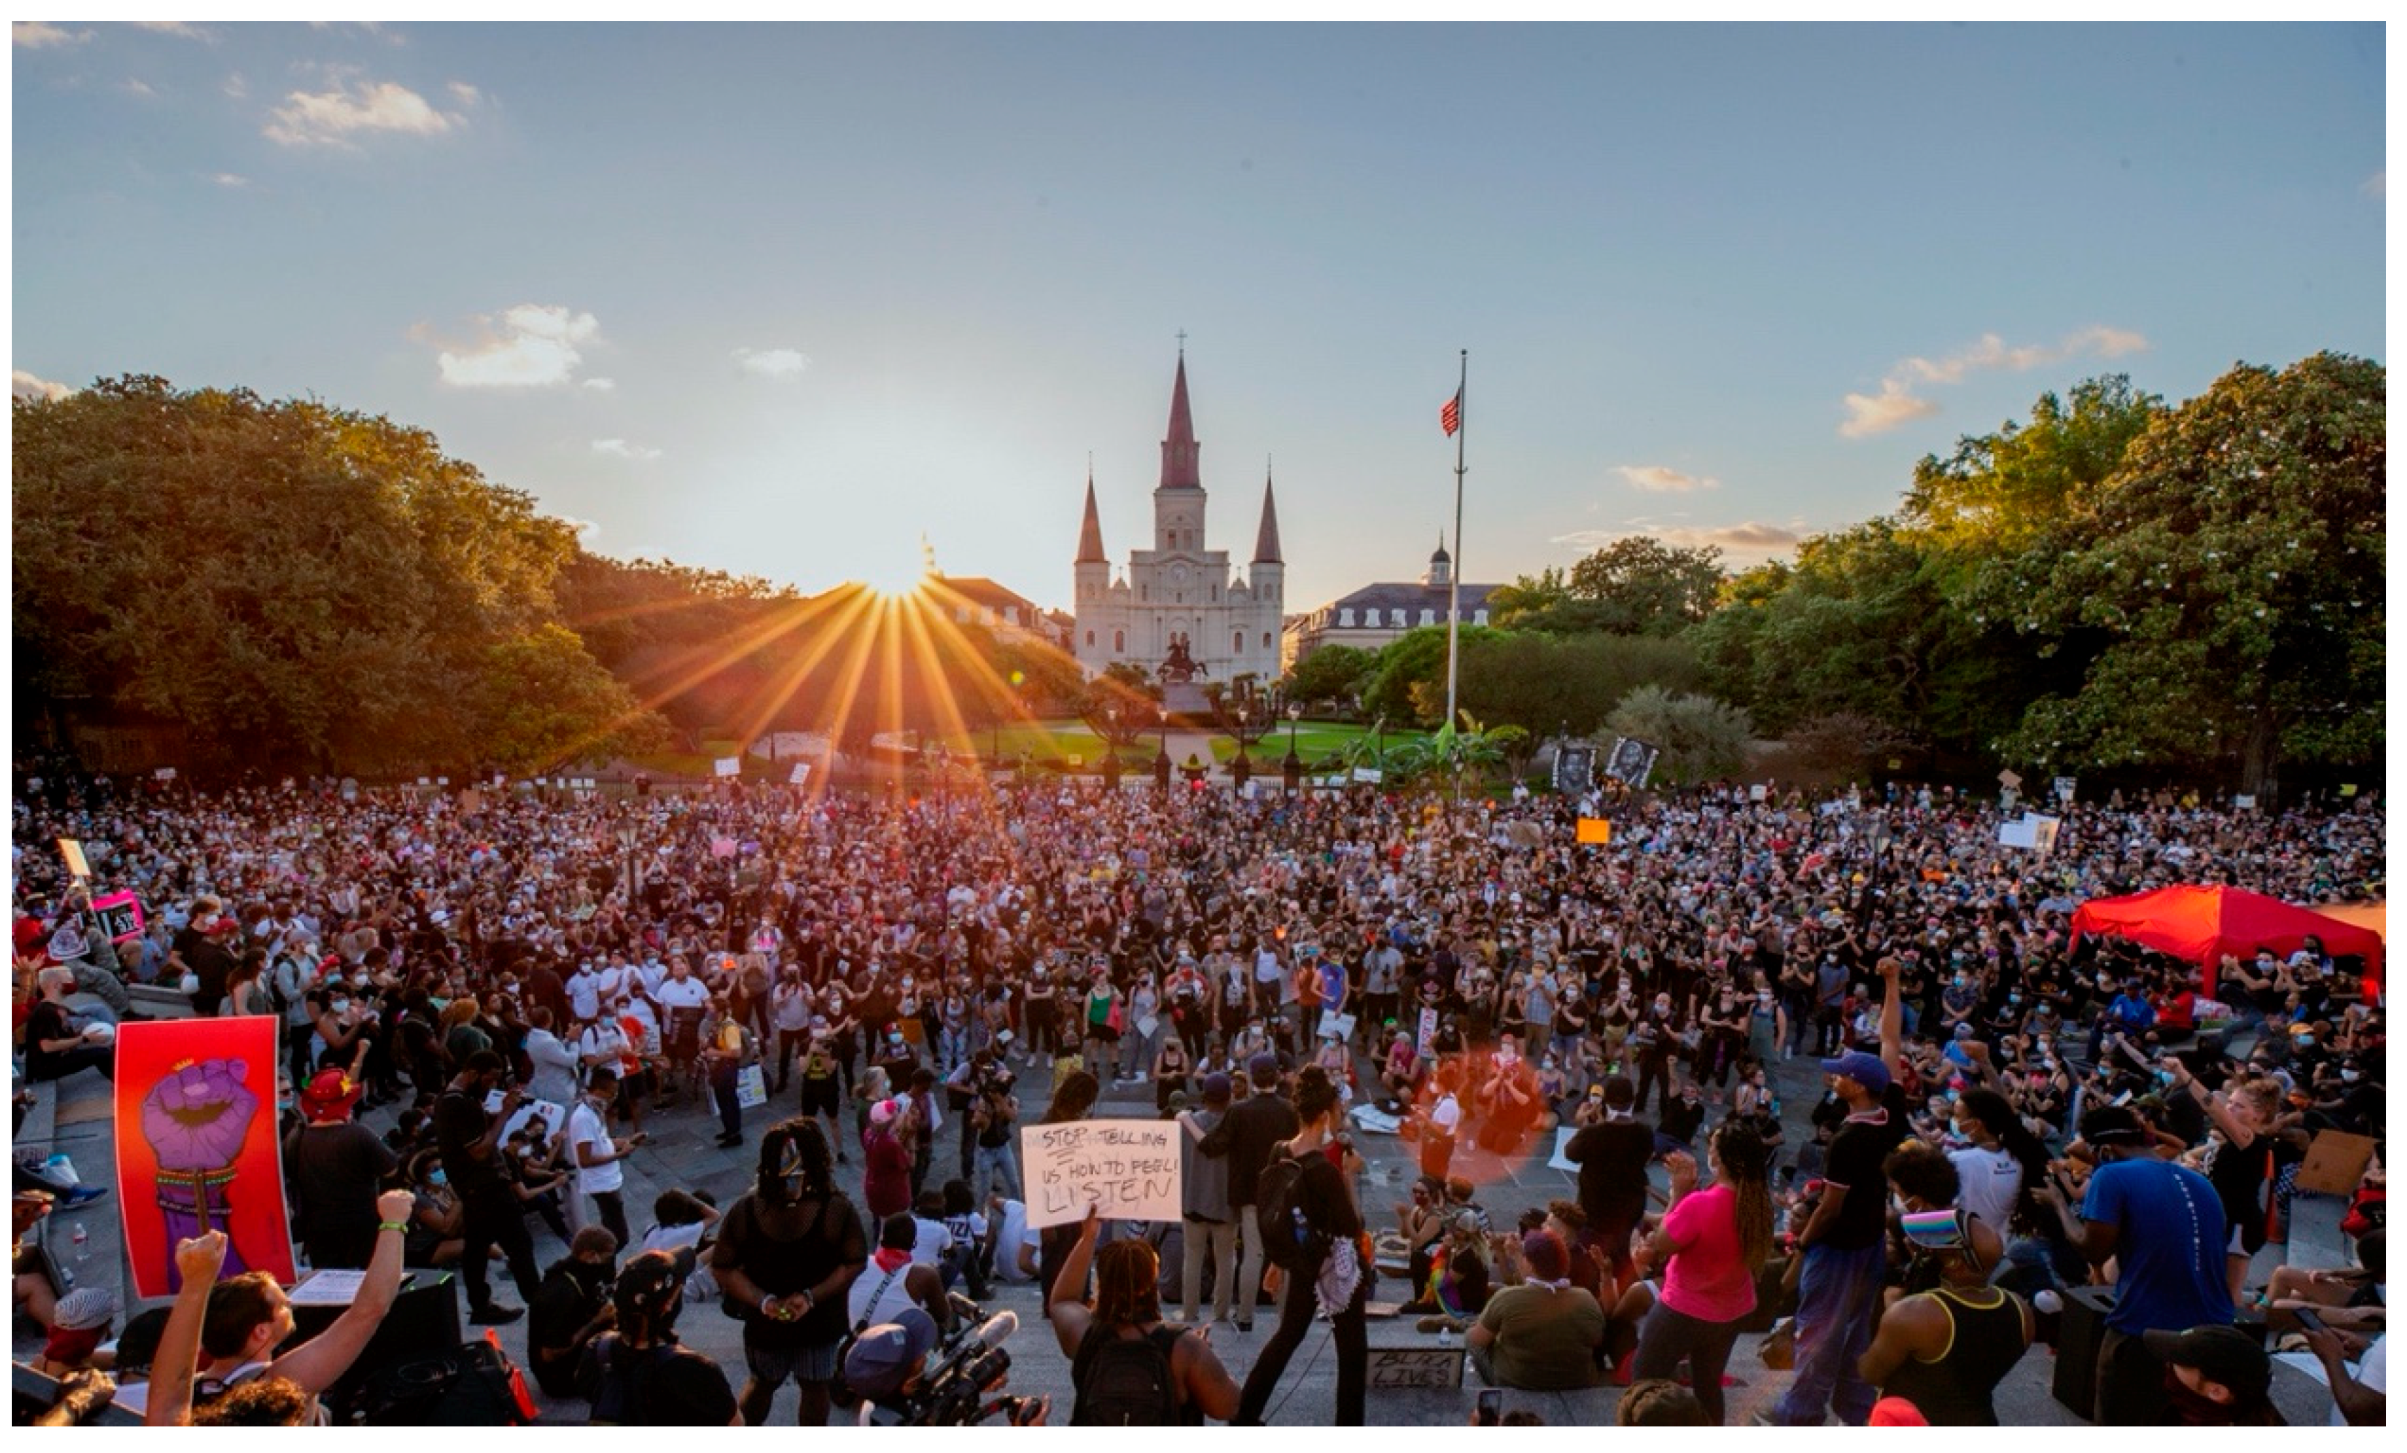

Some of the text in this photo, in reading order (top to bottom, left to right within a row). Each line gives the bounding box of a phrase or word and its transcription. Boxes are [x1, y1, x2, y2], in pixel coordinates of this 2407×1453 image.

[1043, 1127, 1168, 1148] STOP TELLING
[1042, 1169, 1061, 1184] US
[1070, 1162, 1101, 1179] HOW
[1105, 1160, 1125, 1176] TO
[1042, 1177, 1172, 1214] LISTEN
[1373, 1368, 1450, 1384] LIVES
